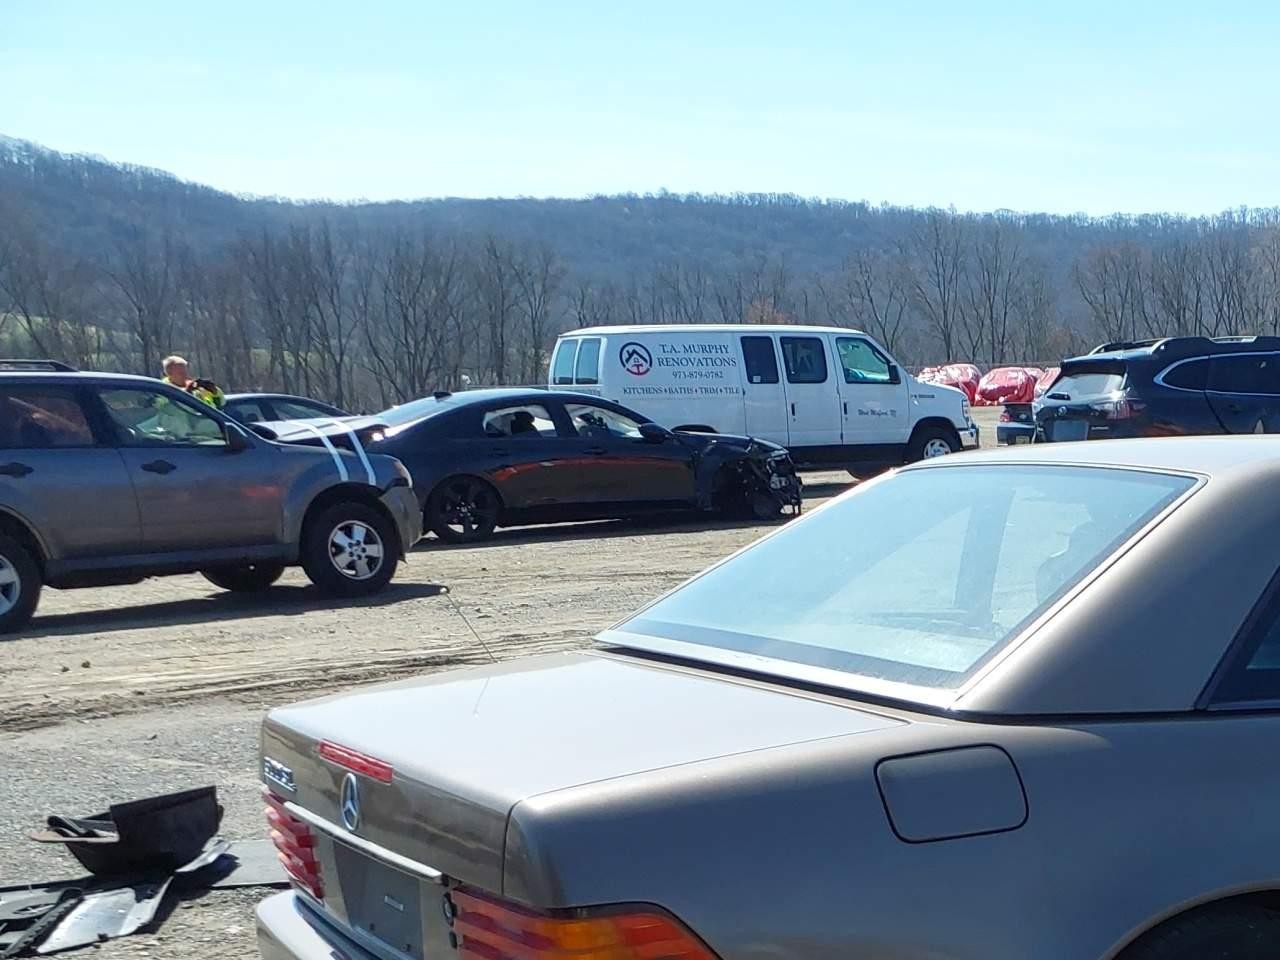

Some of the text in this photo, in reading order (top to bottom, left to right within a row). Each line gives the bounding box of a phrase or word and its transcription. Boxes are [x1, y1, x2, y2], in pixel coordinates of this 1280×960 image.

[659, 344, 729, 354] T.A. MURPHY
[657, 357, 737, 367] RENOVATIONS
[623, 386, 740, 395] KITCHENS BATHS TRIM TILE
